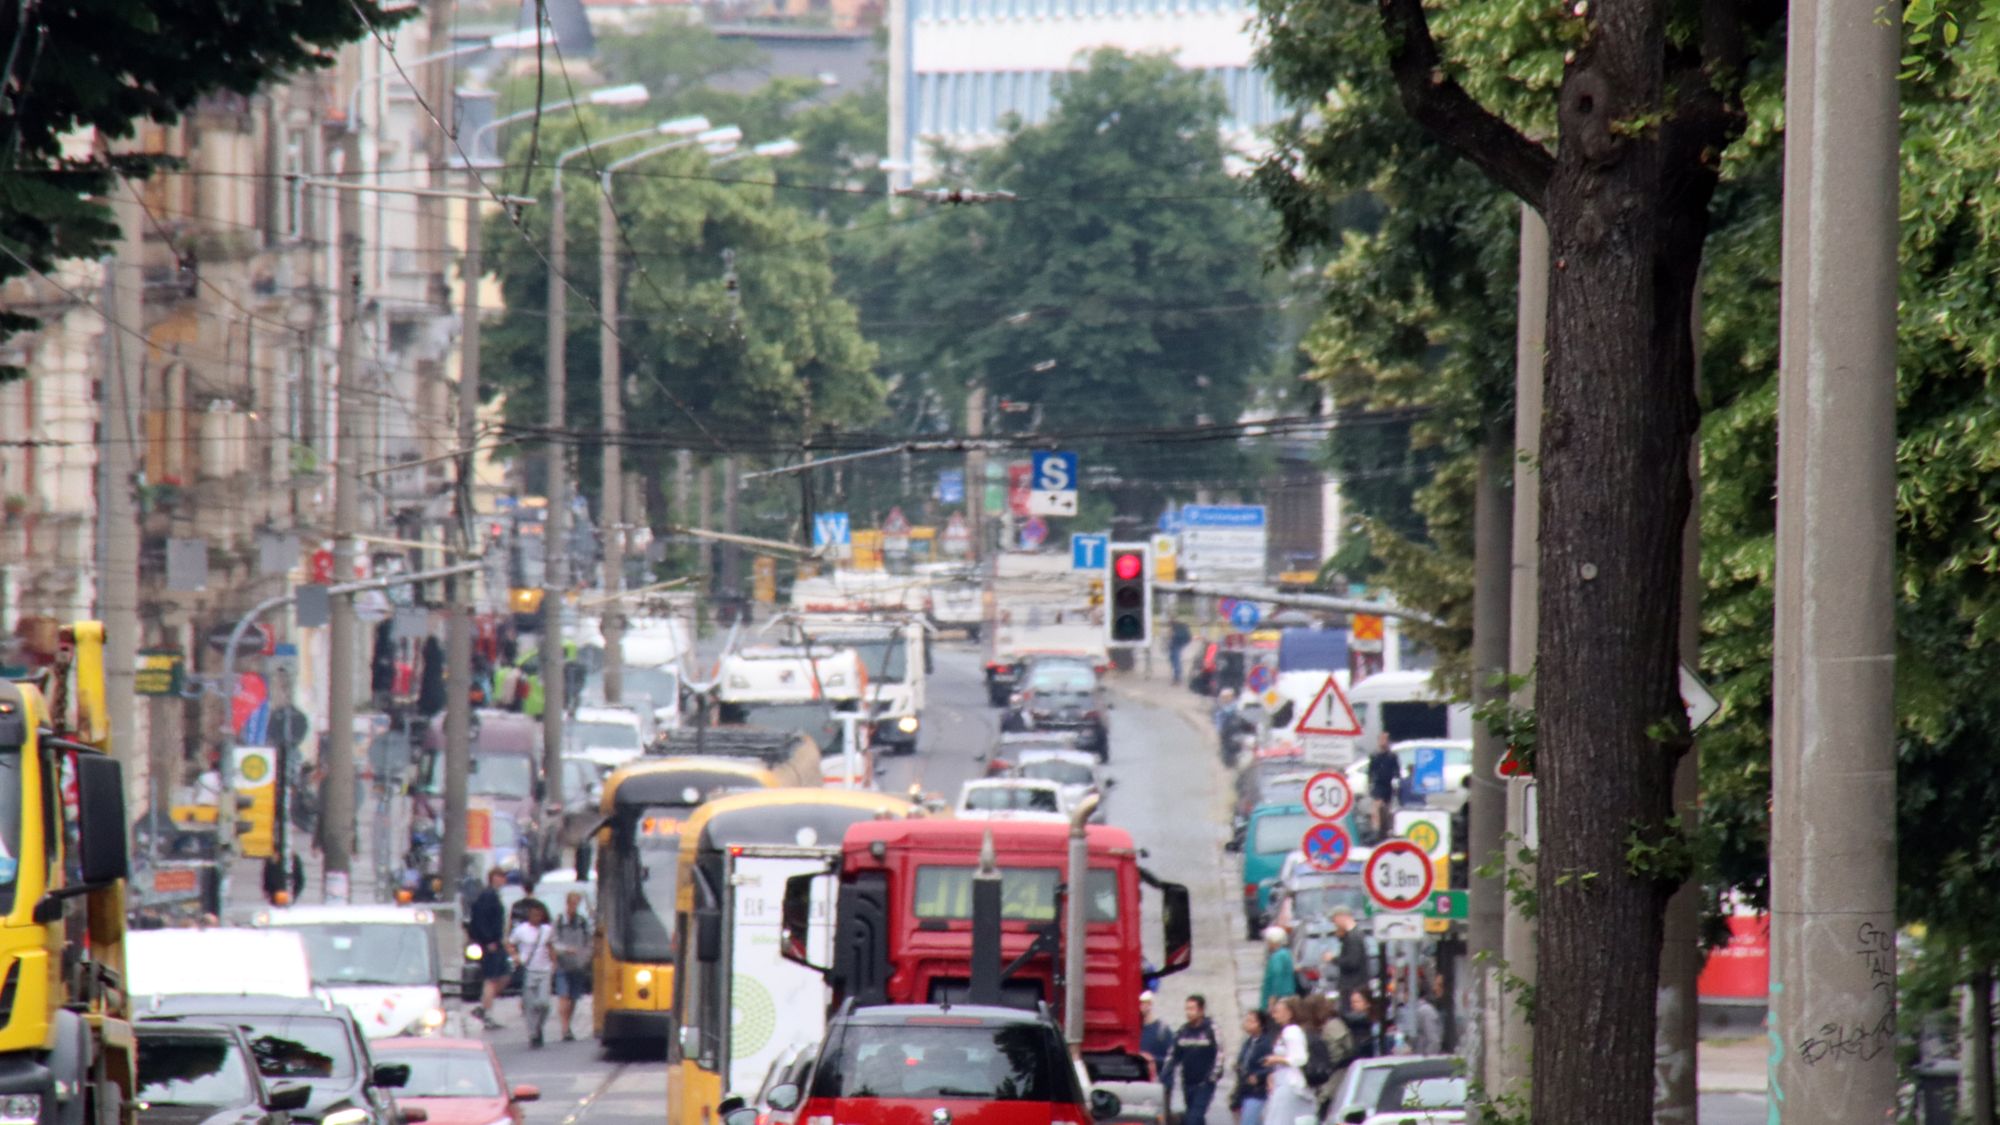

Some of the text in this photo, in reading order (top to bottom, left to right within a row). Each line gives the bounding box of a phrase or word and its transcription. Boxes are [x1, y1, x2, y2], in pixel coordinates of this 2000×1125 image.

[1041, 457, 1068, 490] S
[816, 518, 847, 542] W
[1079, 539, 1100, 566] T
[1315, 786, 1341, 808] 30
[1380, 863, 1420, 888] 3.8m
